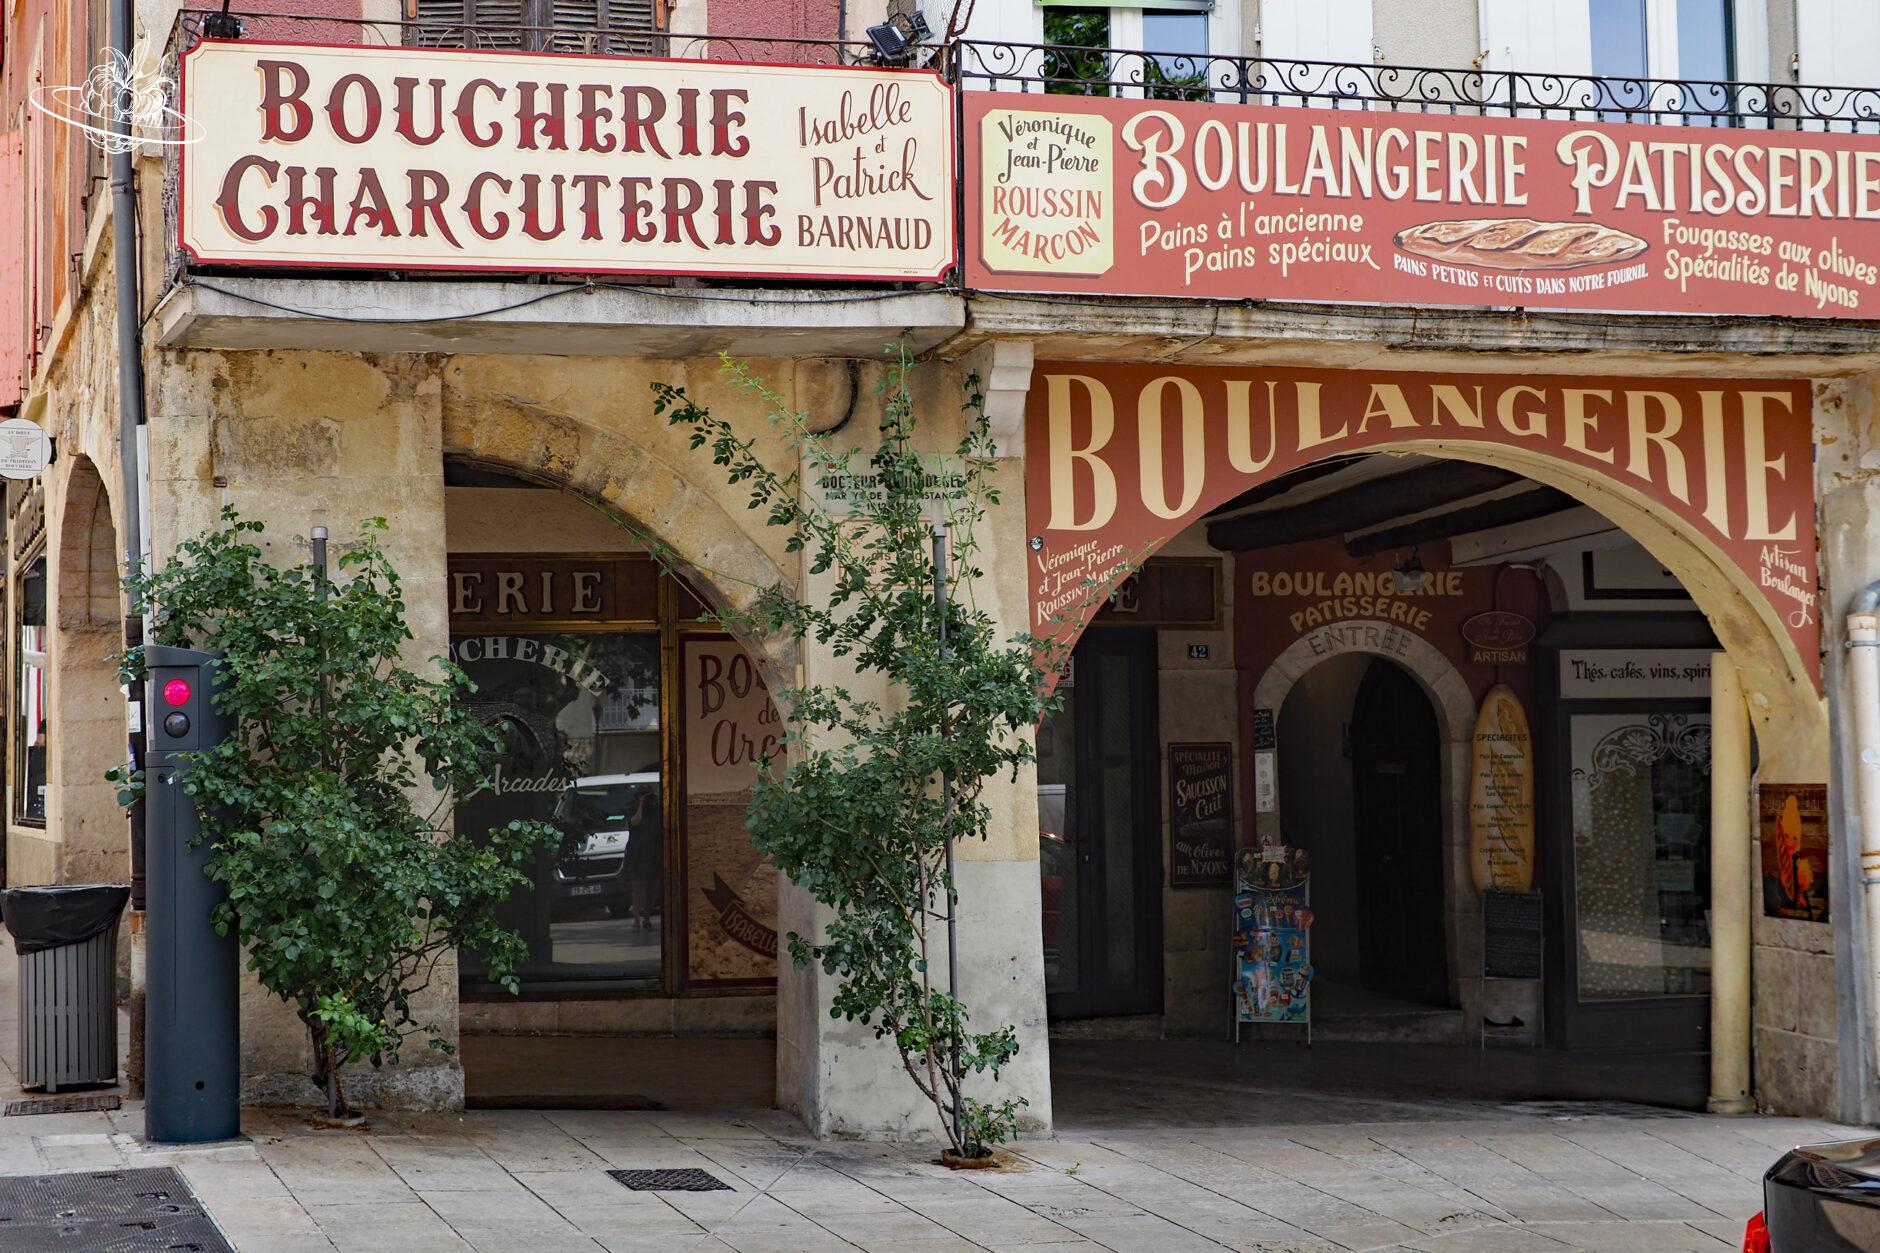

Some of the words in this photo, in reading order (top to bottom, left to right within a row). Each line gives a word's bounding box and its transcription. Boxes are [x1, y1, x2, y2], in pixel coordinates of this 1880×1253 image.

[256, 59, 751, 159] BOUCHERIE
[800, 82, 912, 147] Isabelle
[875, 134, 888, 153] et
[997, 115, 1096, 149] Véronique
[1027, 137, 1040, 151] et
[812, 137, 934, 207] Patrick
[997, 144, 1099, 183] Jean-Pierre
[1121, 110, 1528, 208] BOULANGERIE
[1555, 130, 1880, 220] PATISSERIE
[217, 154, 782, 250] CHARCUTERIE
[993, 186, 1102, 219] ROUSSIN
[797, 215, 932, 252] BARNAUD
[992, 217, 1101, 265] MARCON
[1139, 220, 1208, 257] Pains
[1217, 212, 1232, 239] à
[1239, 200, 1364, 238] l'ancienne
[1183, 243, 1256, 286] Pains
[1268, 236, 1381, 278] spéciaux
[1663, 218, 1774, 258] Fougasses
[1778, 240, 1812, 266] aux
[1818, 236, 1879, 286] olives
[1393, 253, 1428, 278] PAINS
[1431, 264, 1479, 287] PETRIS
[1483, 275, 1494, 288] ET
[1496, 274, 1532, 294] CUITS
[1536, 278, 1566, 294] DANS
[1569, 273, 1605, 293] NOTRE
[1607, 263, 1649, 287] FOURNIL
[1663, 249, 1771, 293] Spécialités
[1775, 262, 1799, 292] de
[1804, 267, 1860, 310] Nyons
[1044, 373, 1799, 542] BOULANGERIE
[1037, 540, 1098, 574] Véronique
[1038, 576, 1050, 595] et
[1051, 544, 1123, 596] Jean-Pierre
[1760, 544, 1810, 583] Artisan
[452, 571, 602, 614] ERIE
[1037, 557, 1129, 627] ROUSSIN-MARC
[1251, 571, 1465, 597] BOULANGRIE
[1760, 566, 1816, 628] Boulanger
[1289, 596, 1433, 632] PATISSERIE
[1190, 645, 1208, 659] 42
[1473, 650, 1527, 663] ARTISAN
[1176, 774, 1227, 807] SAUCISSON
[1195, 793, 1224, 820] Cuit
[1177, 865, 1189, 875] DE
[1191, 859, 1229, 876] NYONS
